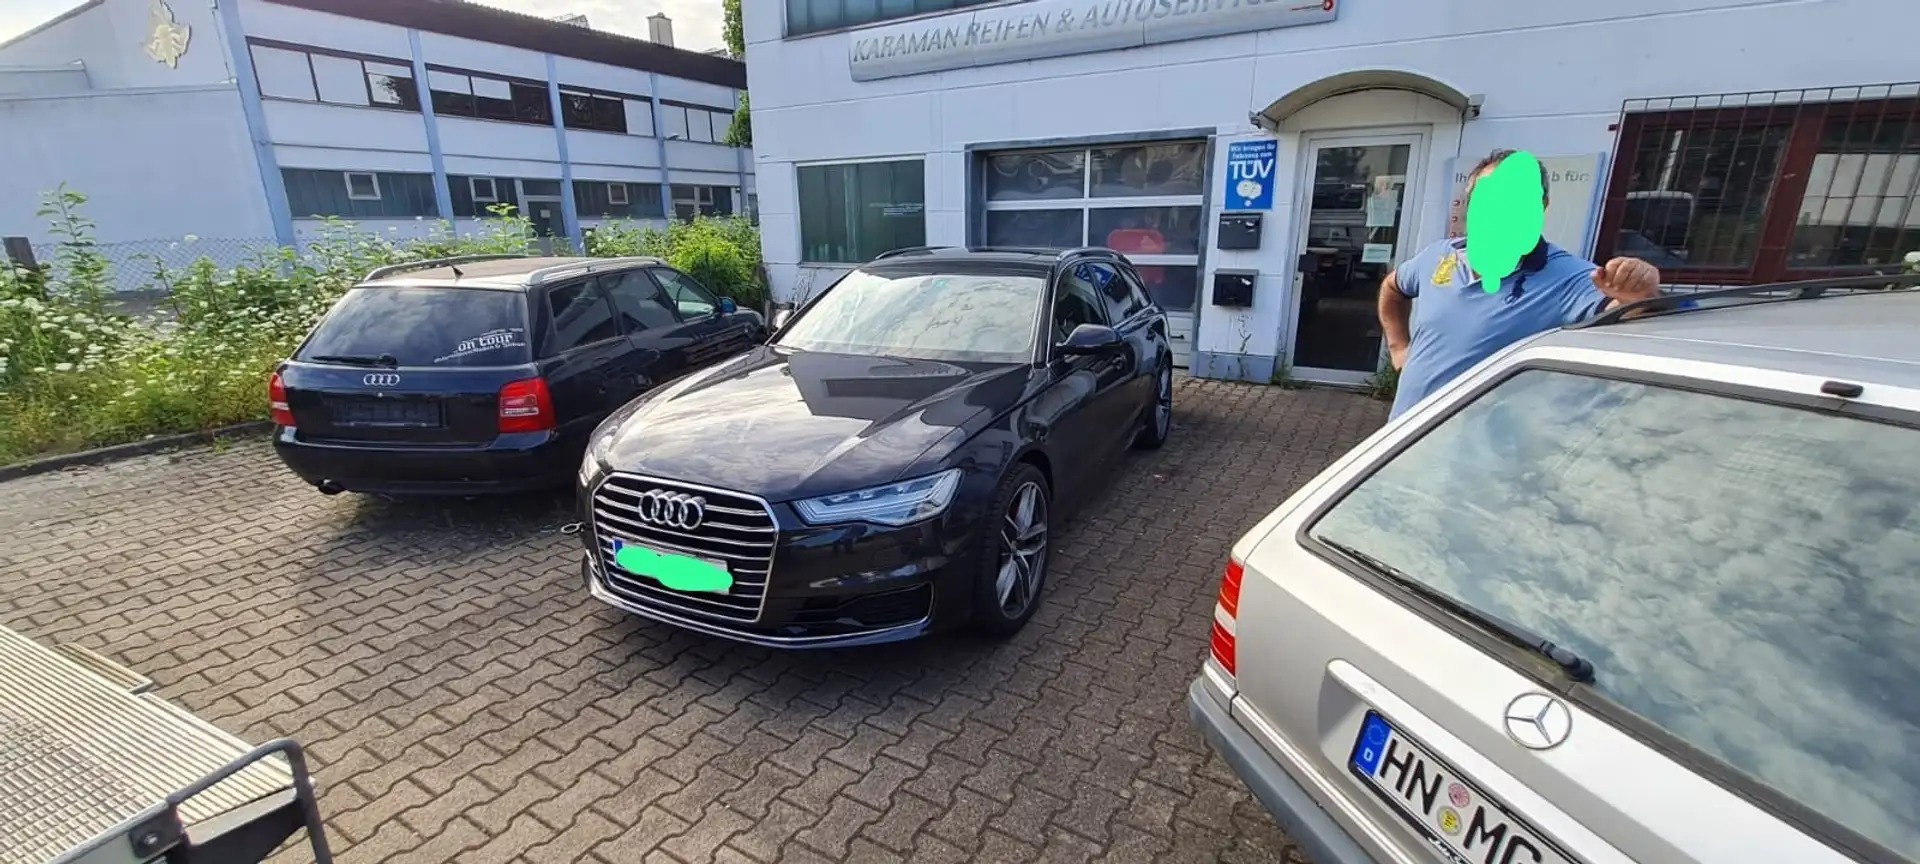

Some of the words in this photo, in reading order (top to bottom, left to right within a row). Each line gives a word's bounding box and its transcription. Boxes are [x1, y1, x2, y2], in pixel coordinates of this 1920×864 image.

[853, 26, 960, 62] KARAMAN
[964, 12, 1050, 46] REIFEN
[1055, 8, 1075, 34] &
[1229, 158, 1274, 179] TÜV
[458, 340, 476, 352] on
[479, 334, 514, 347] tour
[1363, 747, 1374, 762] D
[1379, 738, 1443, 816] HN
